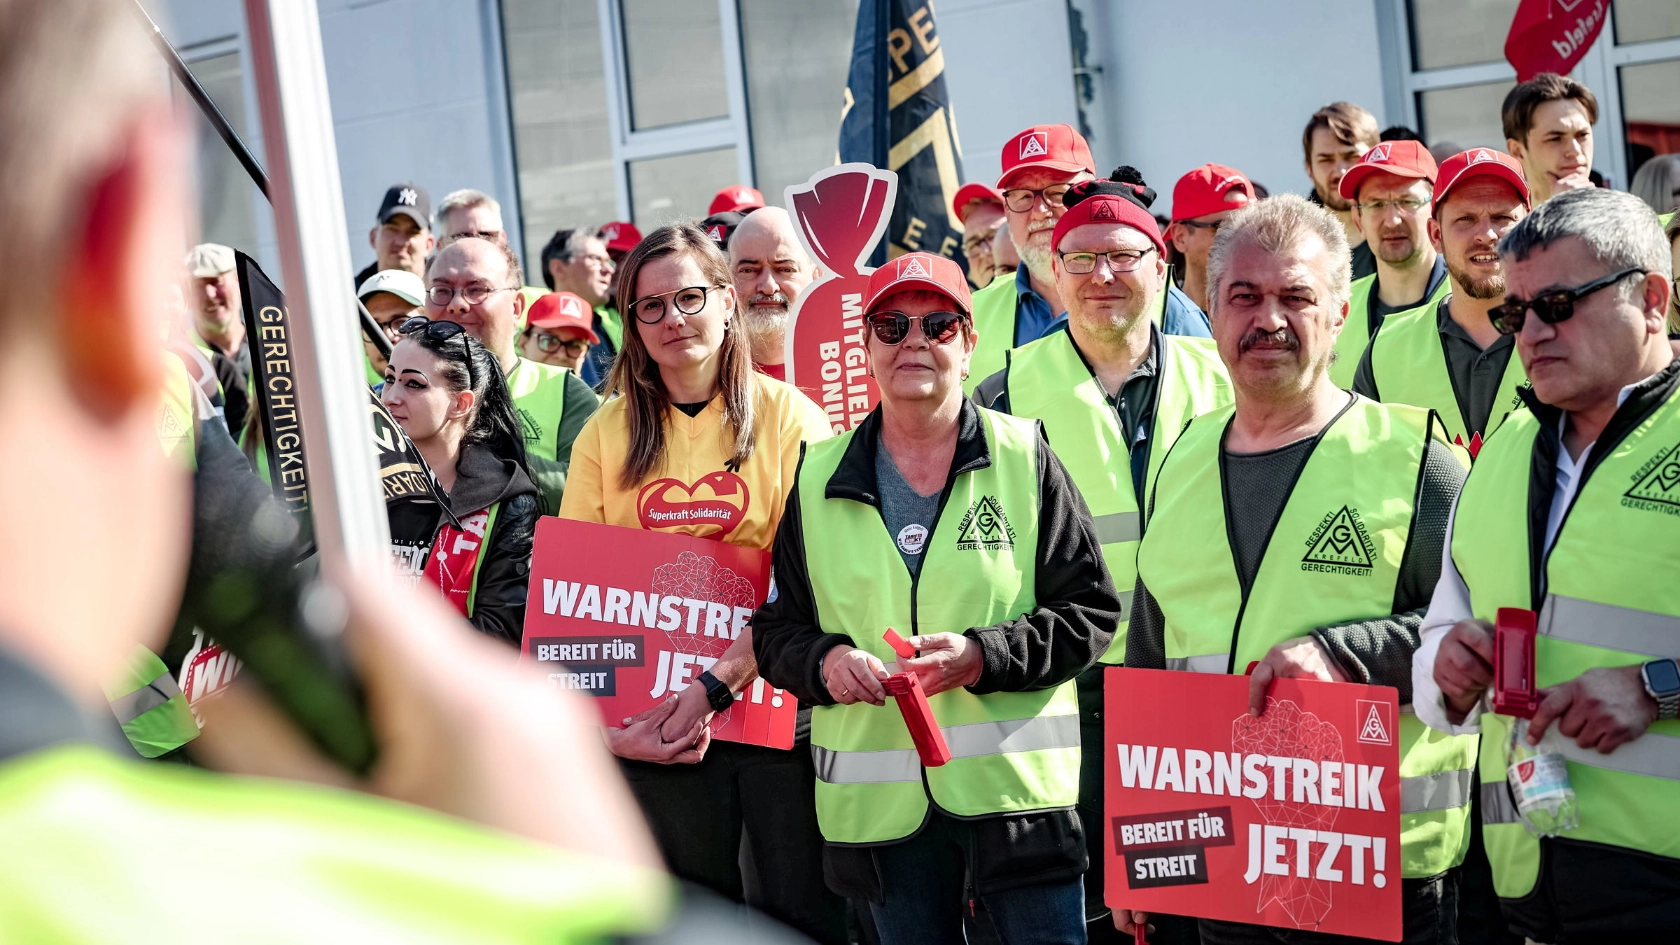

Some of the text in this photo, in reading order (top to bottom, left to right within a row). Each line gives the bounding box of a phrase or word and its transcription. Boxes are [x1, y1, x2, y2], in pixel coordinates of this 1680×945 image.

[648, 508, 732, 522] Superkraft Solidarität
[1304, 510, 1336, 549] RESPEKT!
[1349, 507, 1378, 562] SOLIDARITÄT!
[1300, 562, 1373, 577] GERECHTIGKEIT!
[1314, 553, 1363, 564] KREFELD
[542, 577, 754, 642] WARNSTRE
[537, 638, 637, 662] BEREIT FÜR
[1116, 743, 1386, 812] WARNSTREIK
[1120, 812, 1226, 846] BEREIT FÜR
[1134, 854, 1197, 880] STREIT
[1243, 822, 1387, 889] JETZT!
